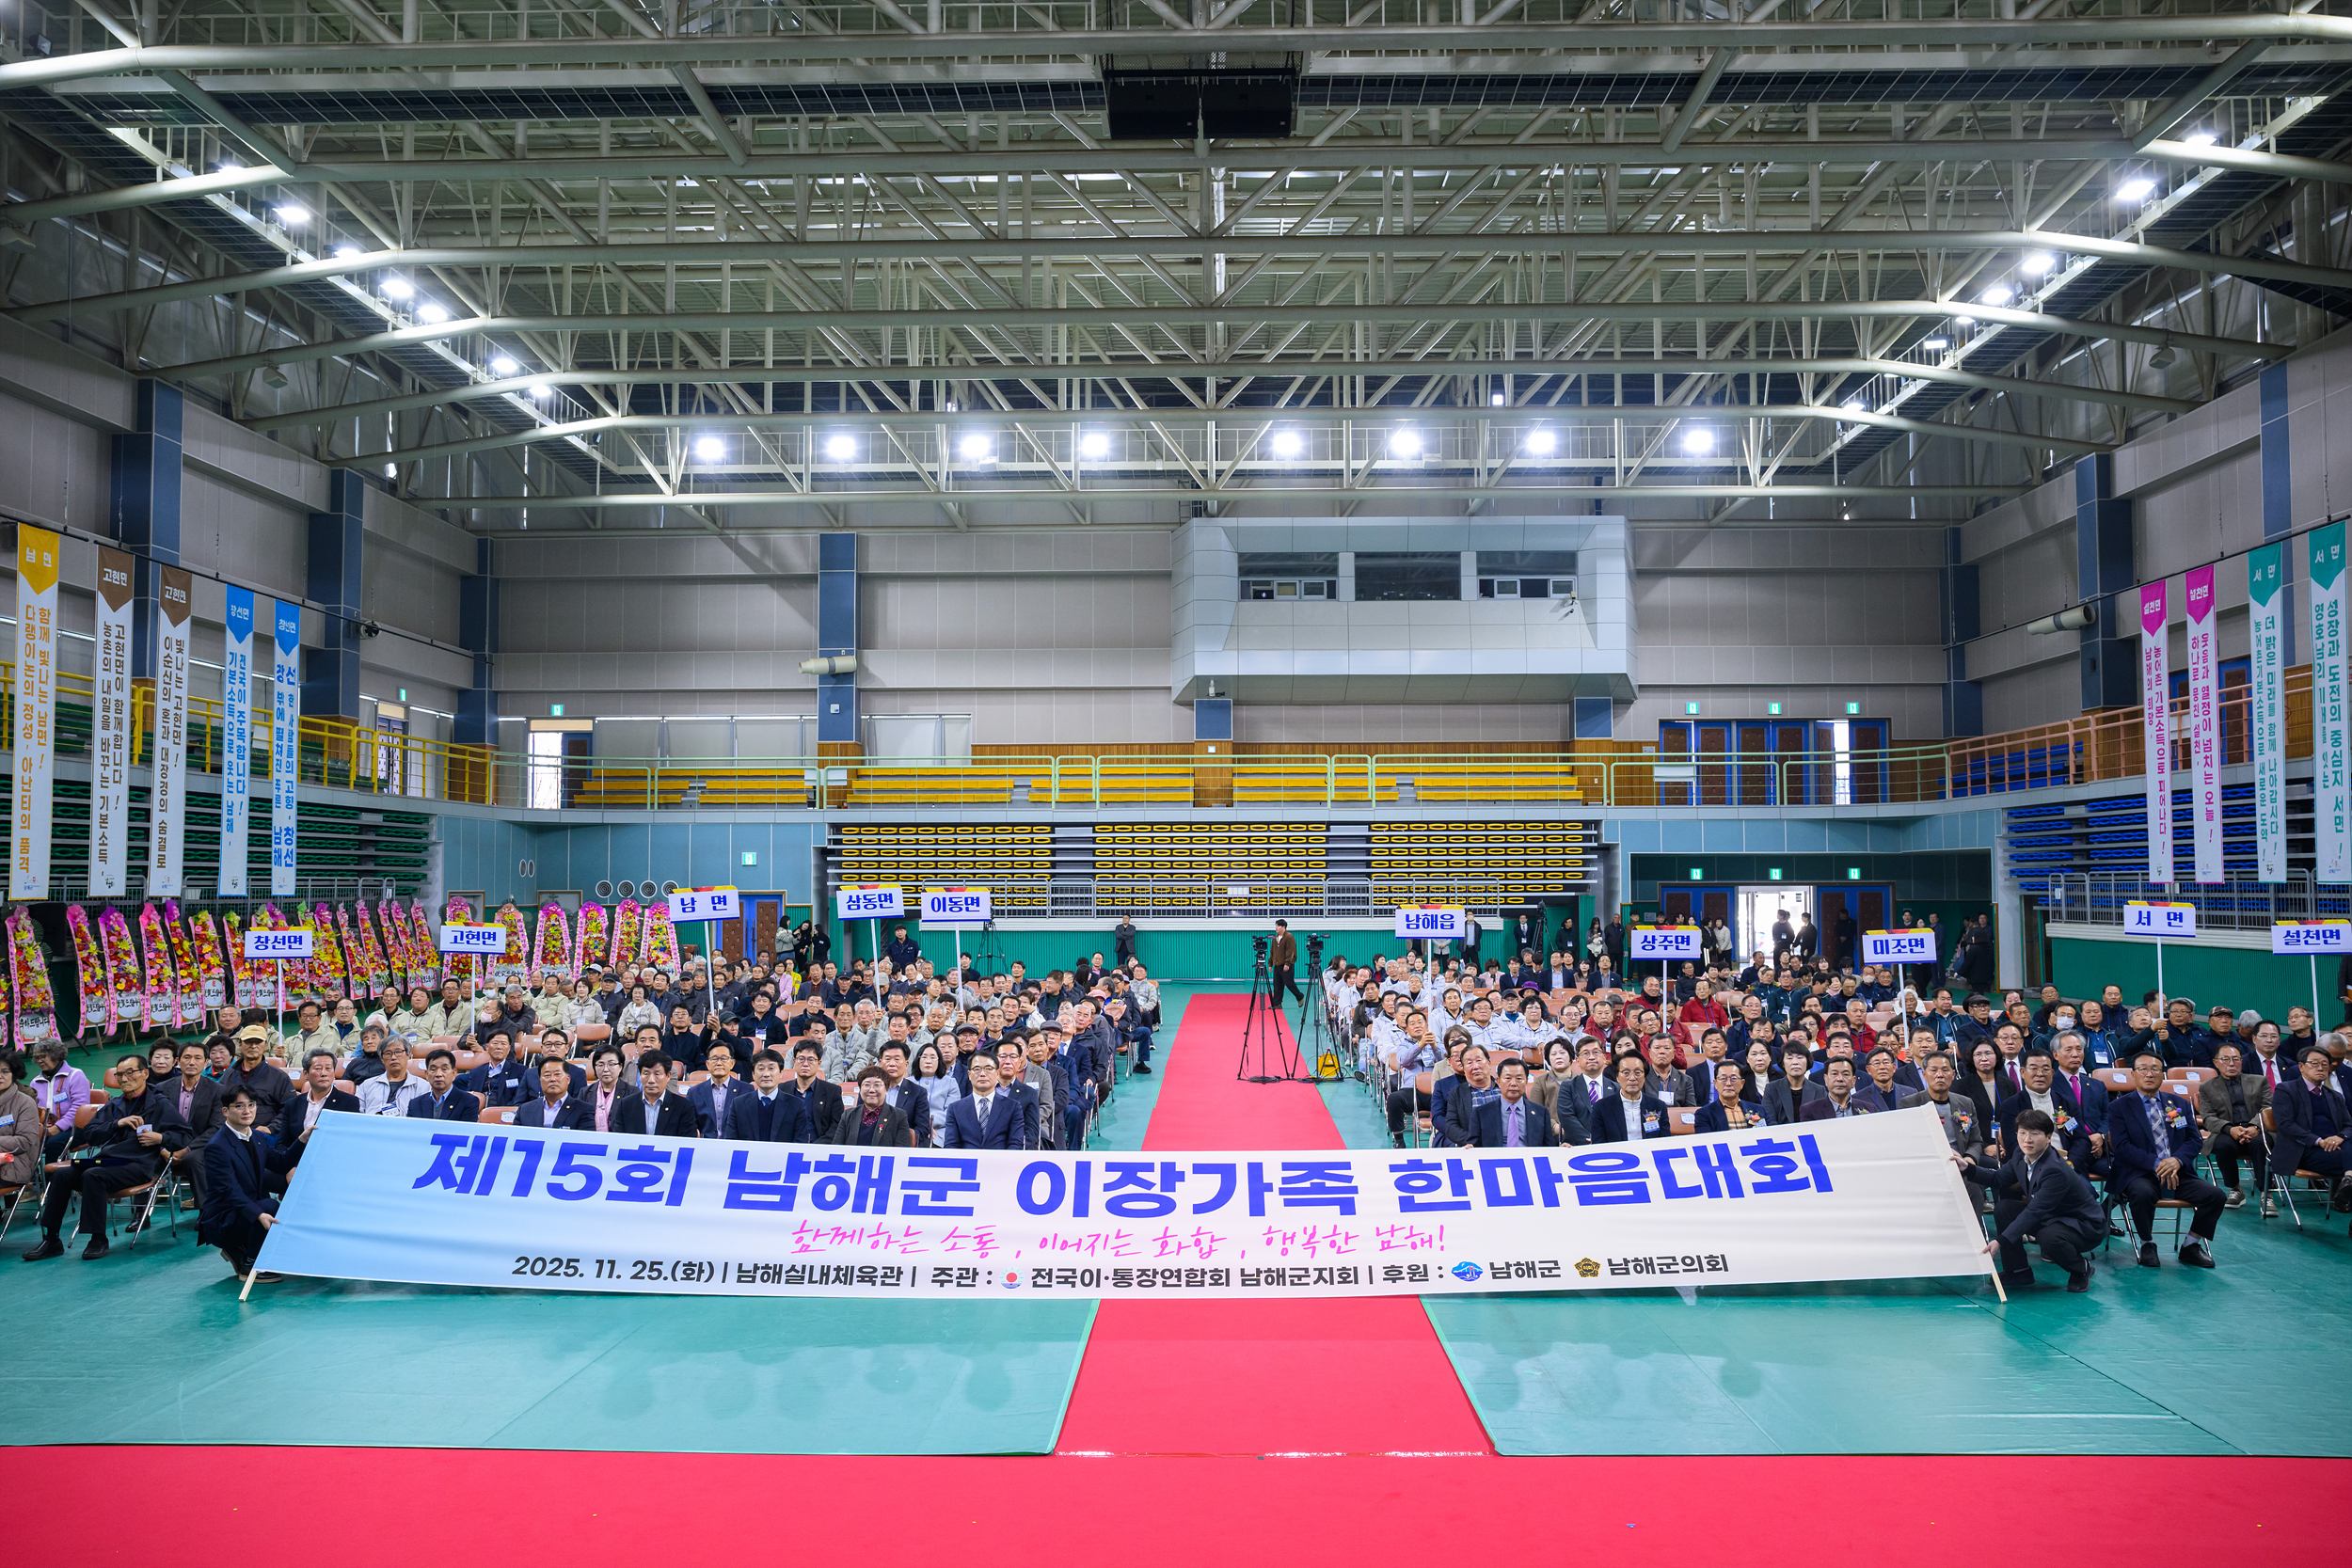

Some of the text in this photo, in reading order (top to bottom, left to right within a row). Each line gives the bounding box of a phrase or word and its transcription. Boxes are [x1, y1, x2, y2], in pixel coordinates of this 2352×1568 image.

[26, 546, 52, 567] 남 면
[2252, 564, 2276, 581] 서 면
[2315, 544, 2340, 564] 서 면
[103, 567, 128, 587] 고현면
[165, 585, 186, 604] 고현면
[40, 607, 51, 643] 함께
[2265, 614, 2275, 629] 더
[2315, 602, 2325, 679] 영호남의
[2328, 599, 2340, 657] 성장과
[24, 604, 36, 697] 다랭이논의
[103, 620, 112, 673] 농촌의
[116, 624, 125, 693] 고현면이
[175, 638, 184, 689] 빛나는
[2265, 636, 2276, 666] 밝은
[39, 650, 50, 705] 빛나는
[163, 636, 173, 703] 이순신의
[238, 654, 246, 705] 전국이
[287, 666, 295, 686] 선
[102, 679, 111, 731] 내일을
[228, 651, 237, 754] 기본소득으로
[2202, 685, 2212, 733] 열정이
[2267, 671, 2276, 717] 미래를
[2329, 664, 2341, 721] 도전의
[162, 707, 171, 740] 혼과
[2155, 690, 2166, 774] 기본소득으로
[2268, 722, 2277, 752] 함께
[101, 736, 111, 789] 바꾸는
[2203, 737, 2214, 785] 넘치는
[2331, 729, 2343, 787] 중심지
[21, 756, 33, 831] 아난티의
[160, 747, 169, 814] 대장경의
[228, 760, 234, 795] 웃는
[276, 778, 281, 809] 푸른
[20, 837, 30, 873] 품격
[157, 819, 167, 869] 숨결로
[274, 826, 282, 867] 남해
[285, 826, 294, 868] 창선
[680, 895, 728, 913] 남 면
[846, 893, 894, 911] 삼동면
[930, 896, 980, 913] 이동면
[1405, 912, 1455, 930] 남해읍
[2136, 911, 2184, 927] 서 면
[253, 935, 303, 951] 창선면
[450, 929, 497, 946] 고현면
[1640, 934, 1691, 951] 상주면
[1872, 937, 1925, 955] 미조면
[2282, 928, 2342, 946] 설천면
[411, 1132, 1835, 1219] 제15회 남해군 이장가족 한마음대회
[790, 1219, 930, 1254] 함께하는
[940, 1225, 1001, 1259] 소통
[1039, 1228, 1142, 1259] 이어지는
[1152, 1226, 1227, 1259] 화합
[1262, 1225, 1360, 1259] 행복한
[1375, 1224, 1445, 1252] 남해!
[512, 1256, 586, 1278] 2025.
[595, 1259, 622, 1279] 11.
[630, 1259, 715, 1283] 25.(화)
[737, 1262, 903, 1288] 남해실내체육관
[1031, 1267, 1231, 1289] 전국이·통장연합회
[1240, 1266, 1359, 1288] 남해군지회
[1489, 1259, 1562, 1280] 남해군
[1607, 1254, 1729, 1276] 남해군의회
